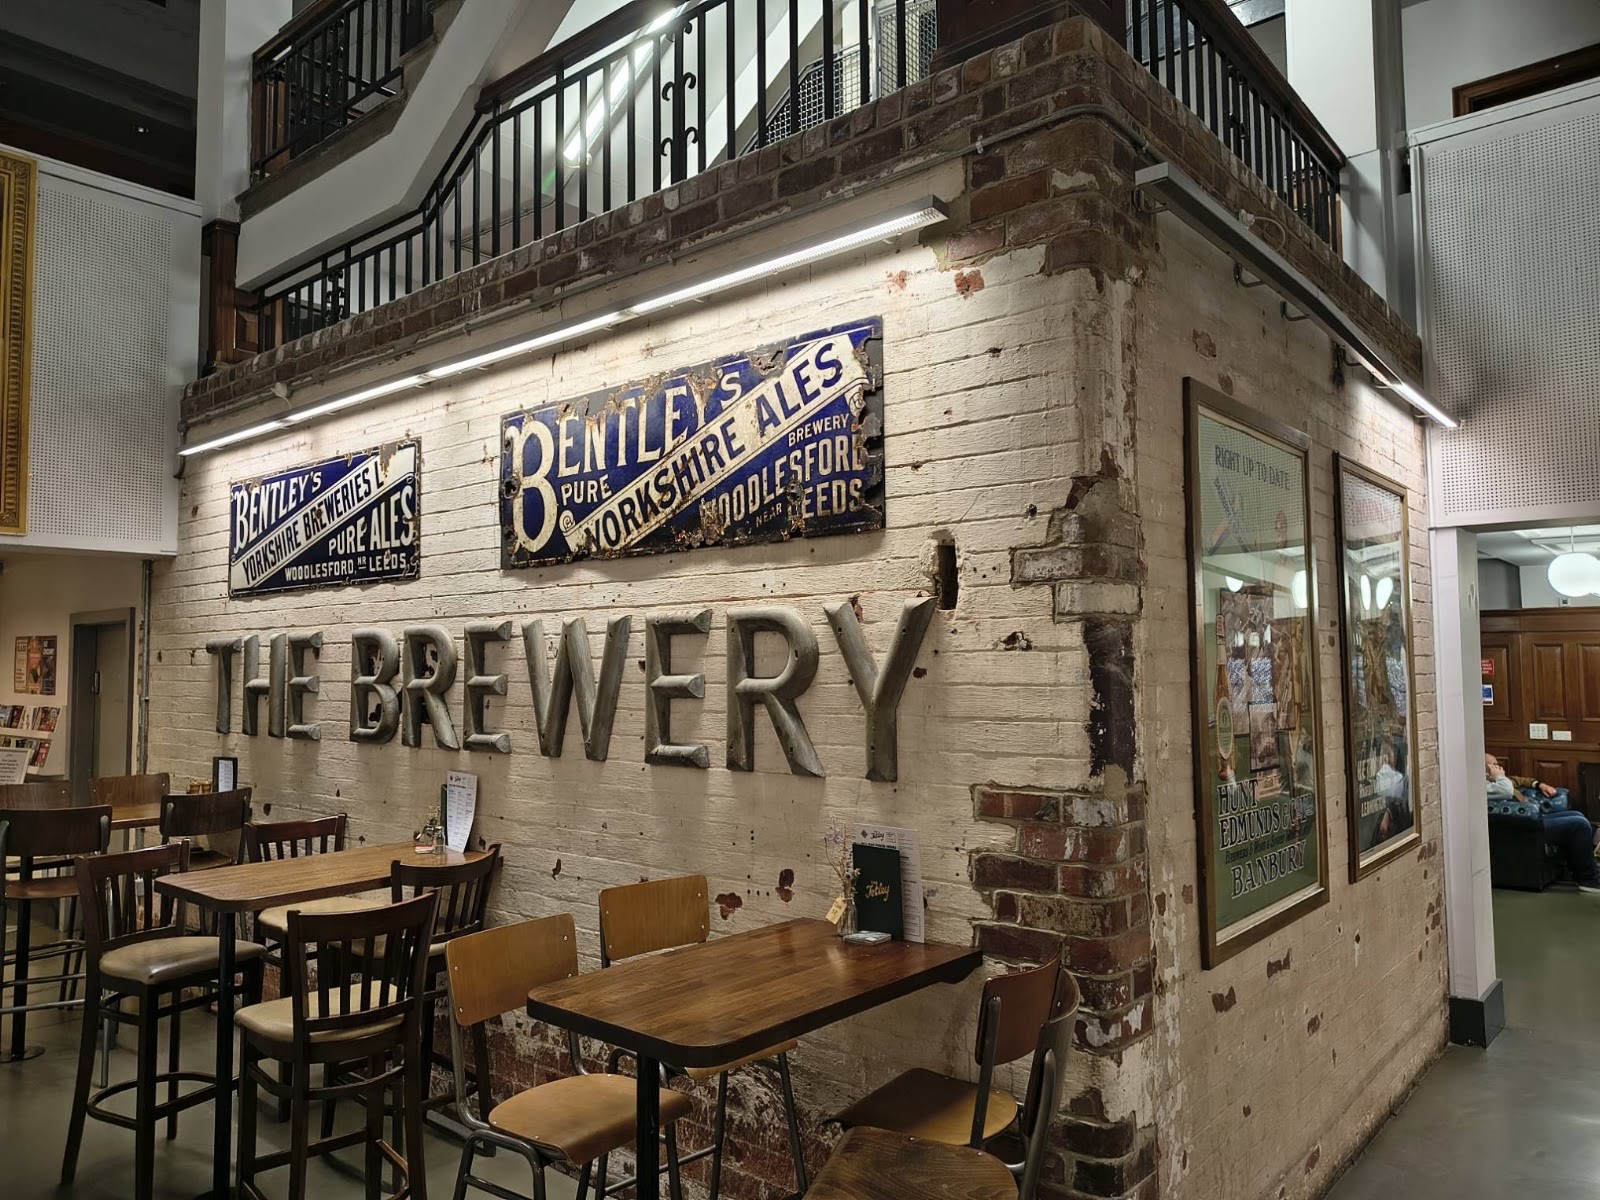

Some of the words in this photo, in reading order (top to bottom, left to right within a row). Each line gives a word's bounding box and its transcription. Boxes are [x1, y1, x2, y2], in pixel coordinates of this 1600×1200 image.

[584, 416, 747, 552] YORKSHIRE
[757, 342, 843, 439] ALES
[788, 413, 850, 448] BREWERY
[504, 367, 741, 553] BENTLEY'S
[1215, 445, 1240, 473] RIGHT
[1242, 454, 1254, 478] UP
[1257, 460, 1267, 483] TO
[1269, 466, 1290, 491] DATE
[232, 471, 322, 553] BENTLEY'S
[561, 473, 612, 506] PURE
[755, 502, 782, 527] NEAR
[242, 520, 301, 585] YORKSHIRE
[303, 467, 372, 541] BREWERIES
[328, 513, 368, 557] PURE
[369, 485, 414, 551] ALES
[206, 630, 323, 741] THE
[349, 596, 937, 782] BREWERY
[1217, 777, 1259, 818] HUNT
[1219, 802, 1281, 851] EDMUNDS
[865, 882, 890, 902] Tetley
[1231, 839, 1307, 900] BANBURY
